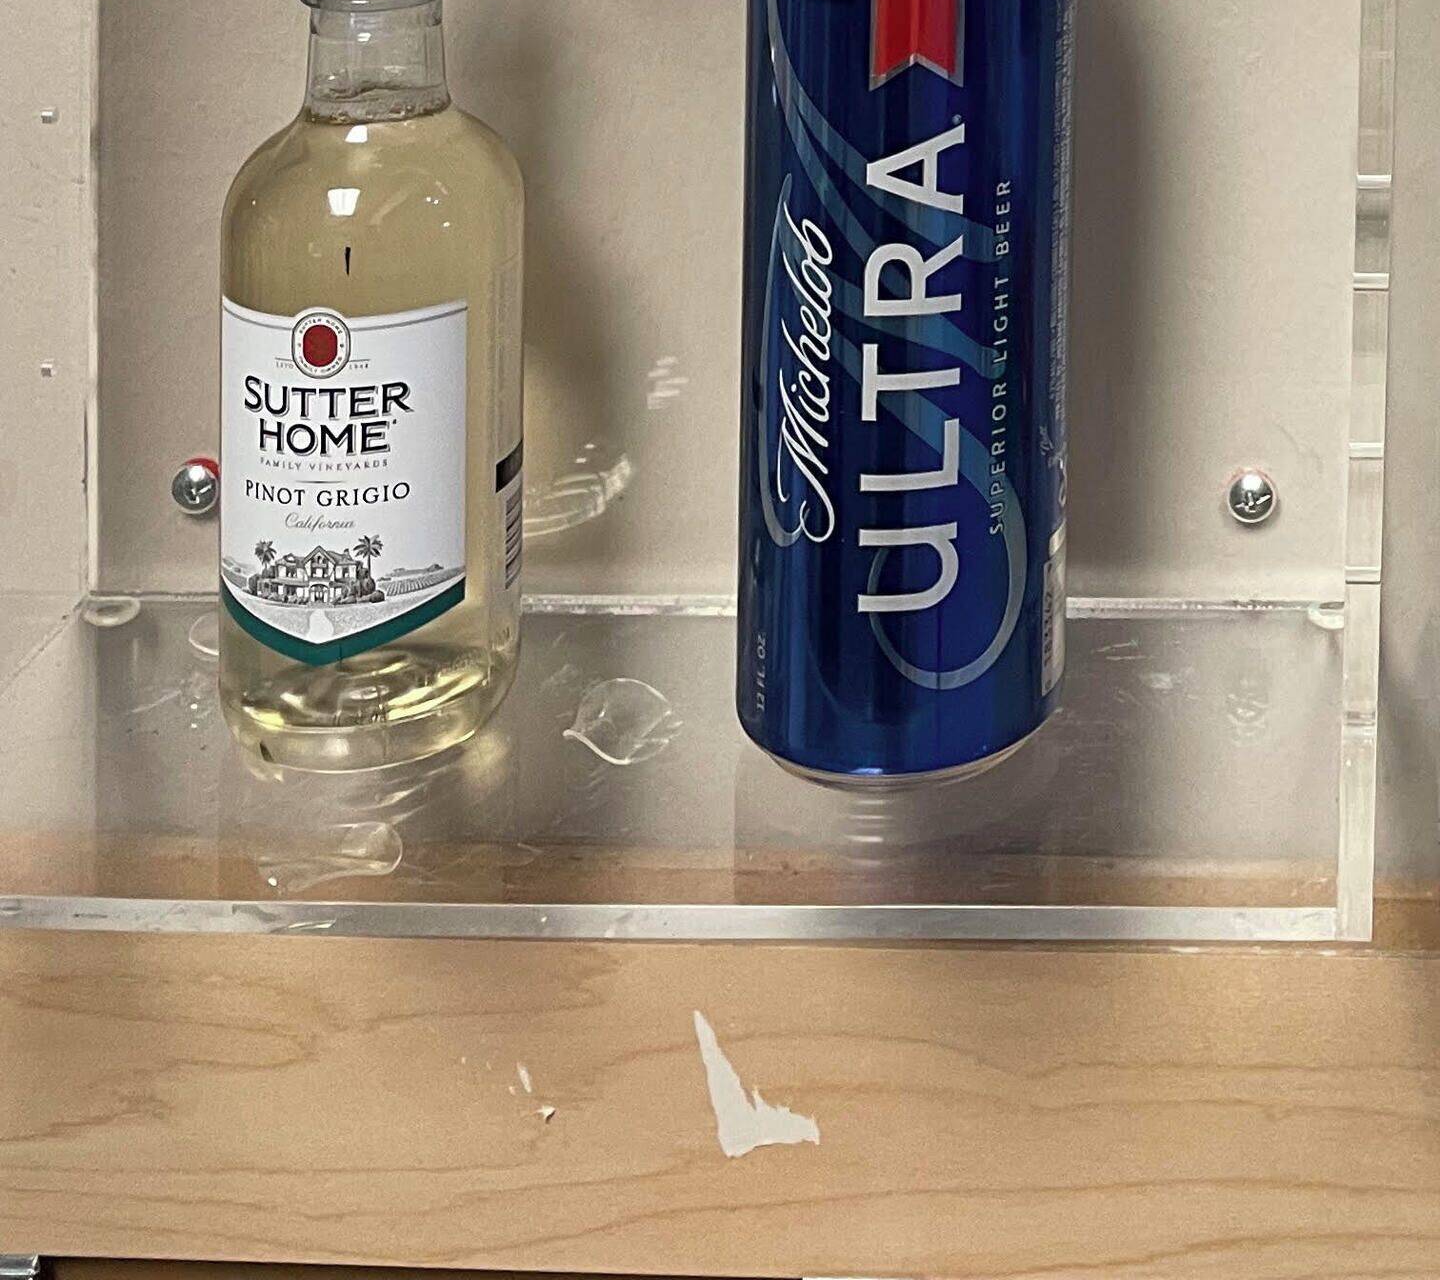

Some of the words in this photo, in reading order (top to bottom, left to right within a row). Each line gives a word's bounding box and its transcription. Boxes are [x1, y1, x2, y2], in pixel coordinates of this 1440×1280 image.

[995, 179, 1012, 257] BEER
[994, 274, 1010, 366] LIGHT
[777, 200, 836, 544] Michelob
[857, 122, 965, 613] ULTRA
[243, 375, 415, 421] SUTTER
[258, 418, 392, 458] HOME
[989, 380, 1008, 536] SUPERIOR
[260, 458, 302, 472] FAMILY
[308, 459, 389, 472] VINEYARDS
[245, 479, 305, 506] PINOT
[316, 481, 412, 508] GRIGIO
[285, 512, 356, 532] California
[756, 694, 767, 713] 12
